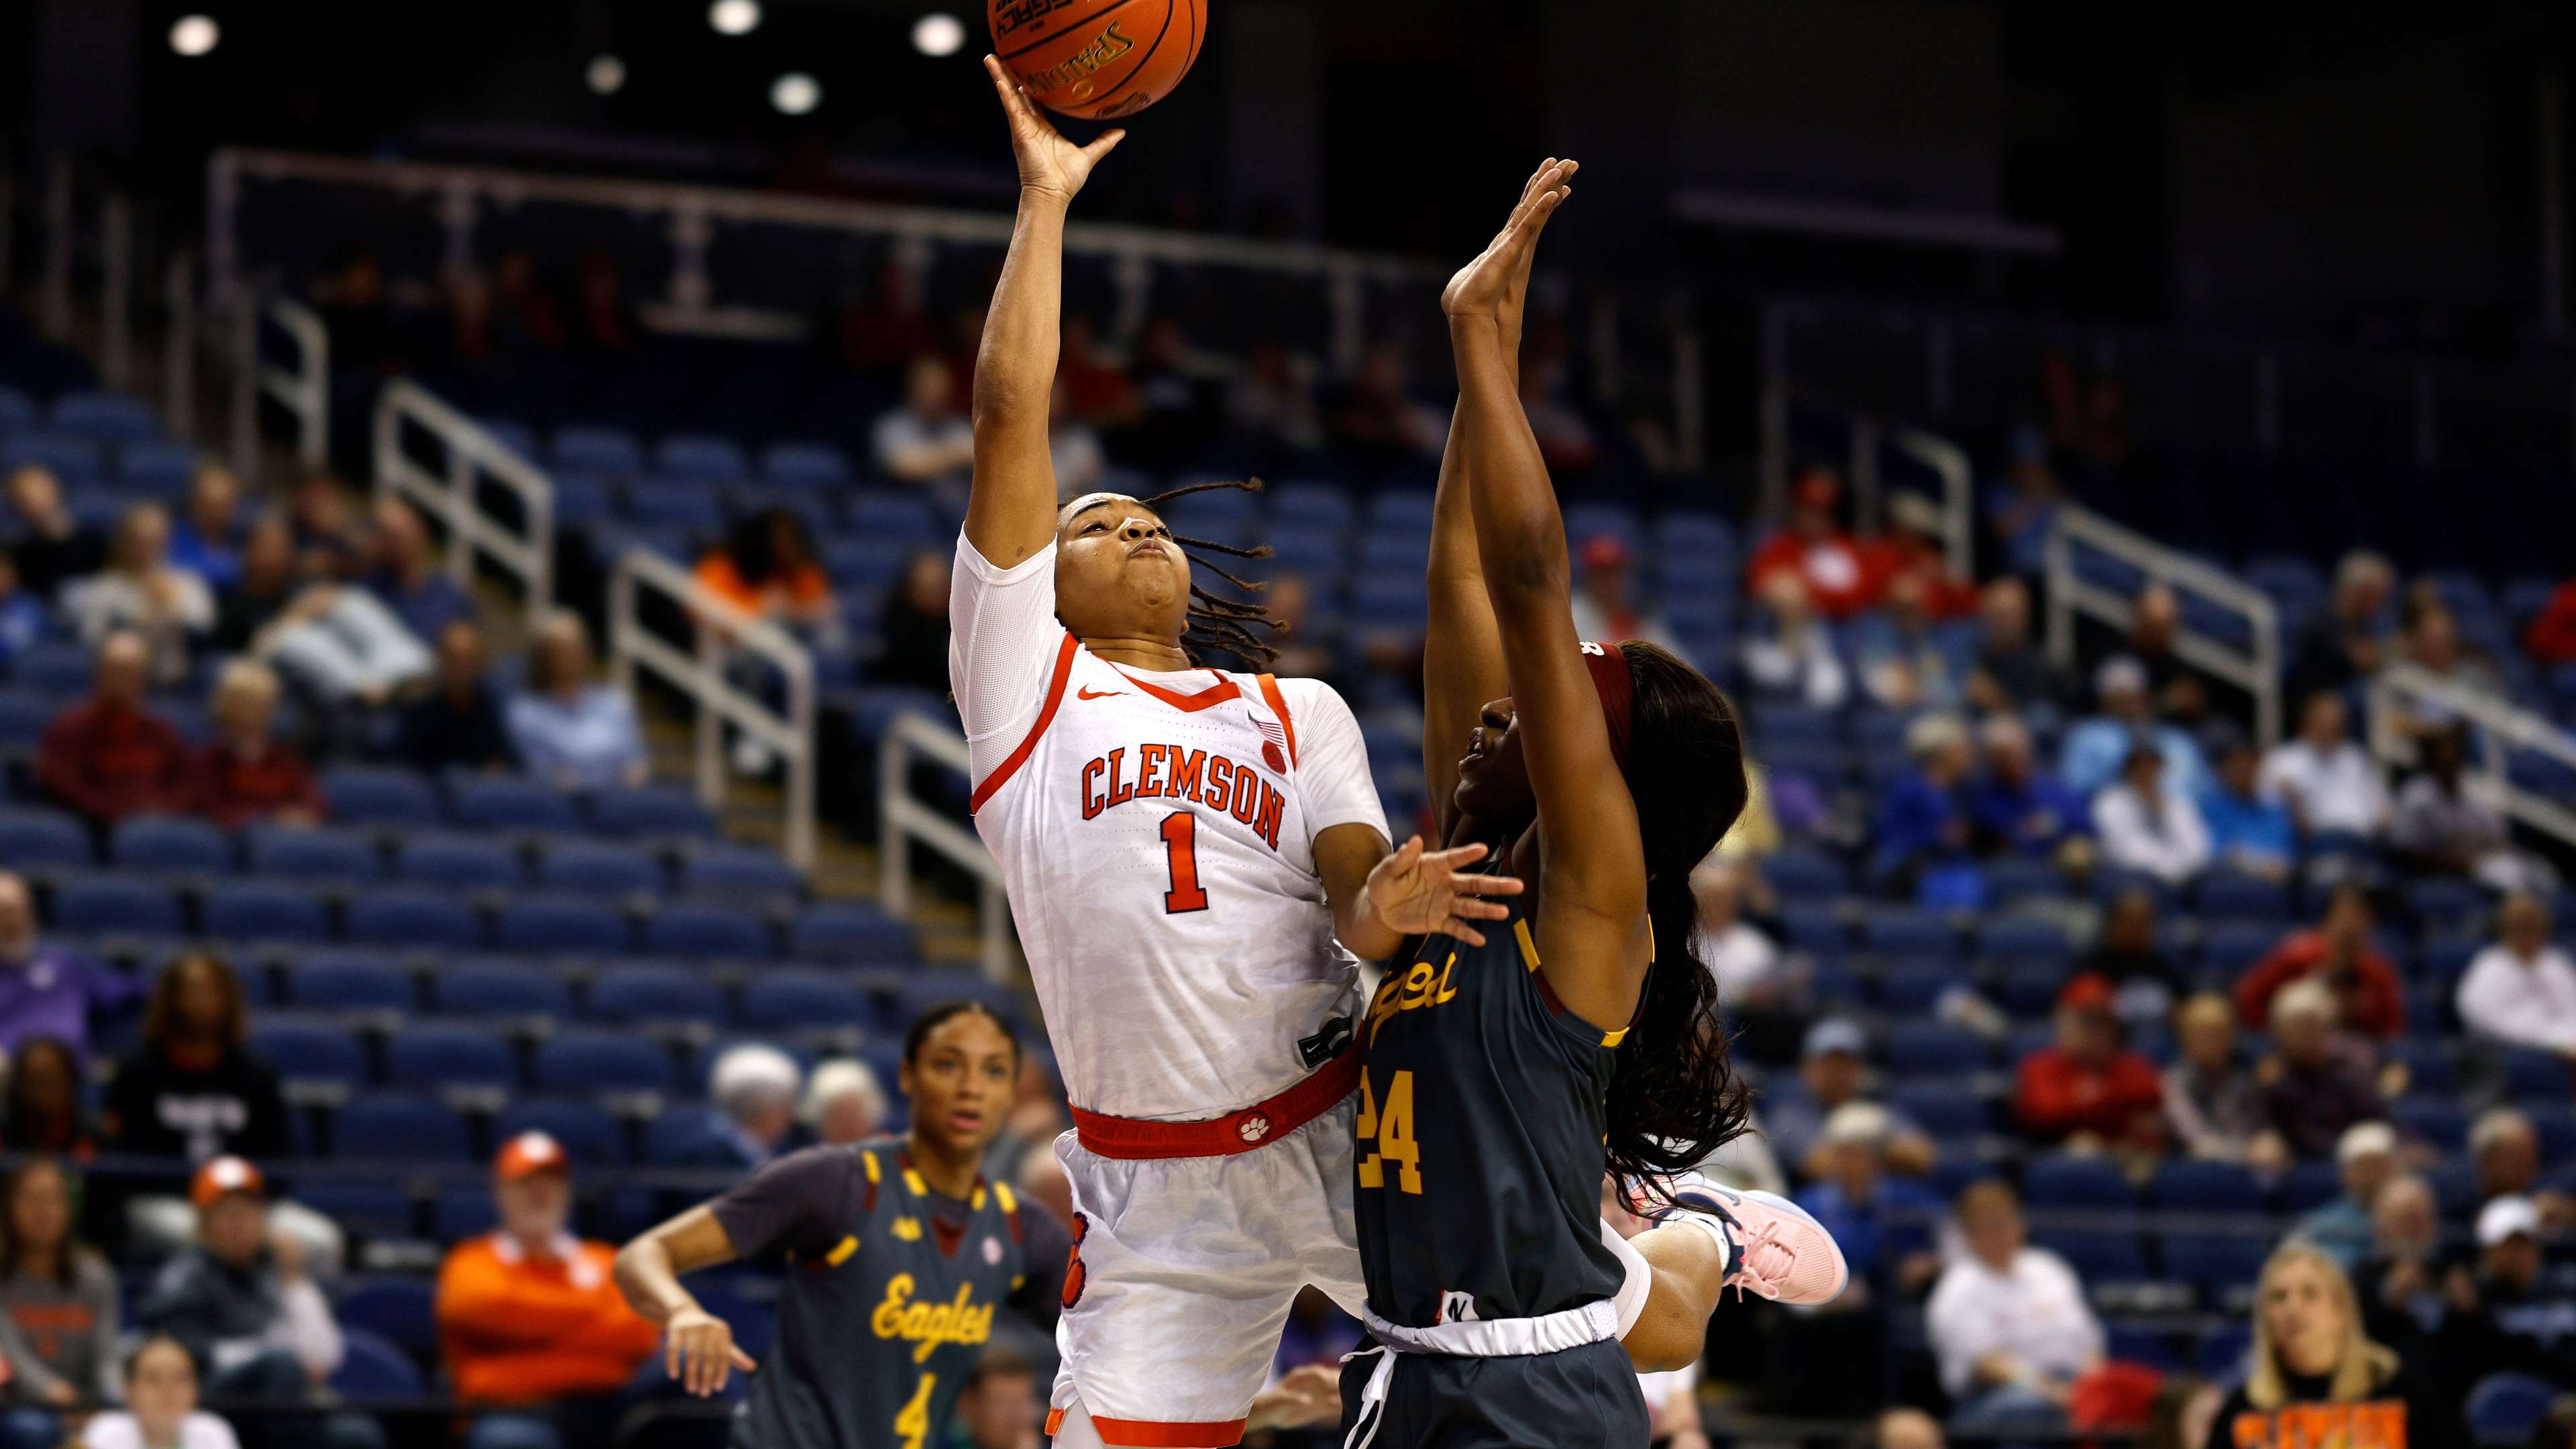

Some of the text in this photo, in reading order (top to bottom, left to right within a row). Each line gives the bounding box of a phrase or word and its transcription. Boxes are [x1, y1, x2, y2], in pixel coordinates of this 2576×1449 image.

[1021, 19, 1135, 95] SPALDIN
[1082, 743, 1285, 852] CLEMSON
[1160, 811, 1208, 914] 1
[1357, 1065, 1422, 1194] 24
[871, 1273, 994, 1364] Eagles
[895, 1373, 938, 1449] 4
